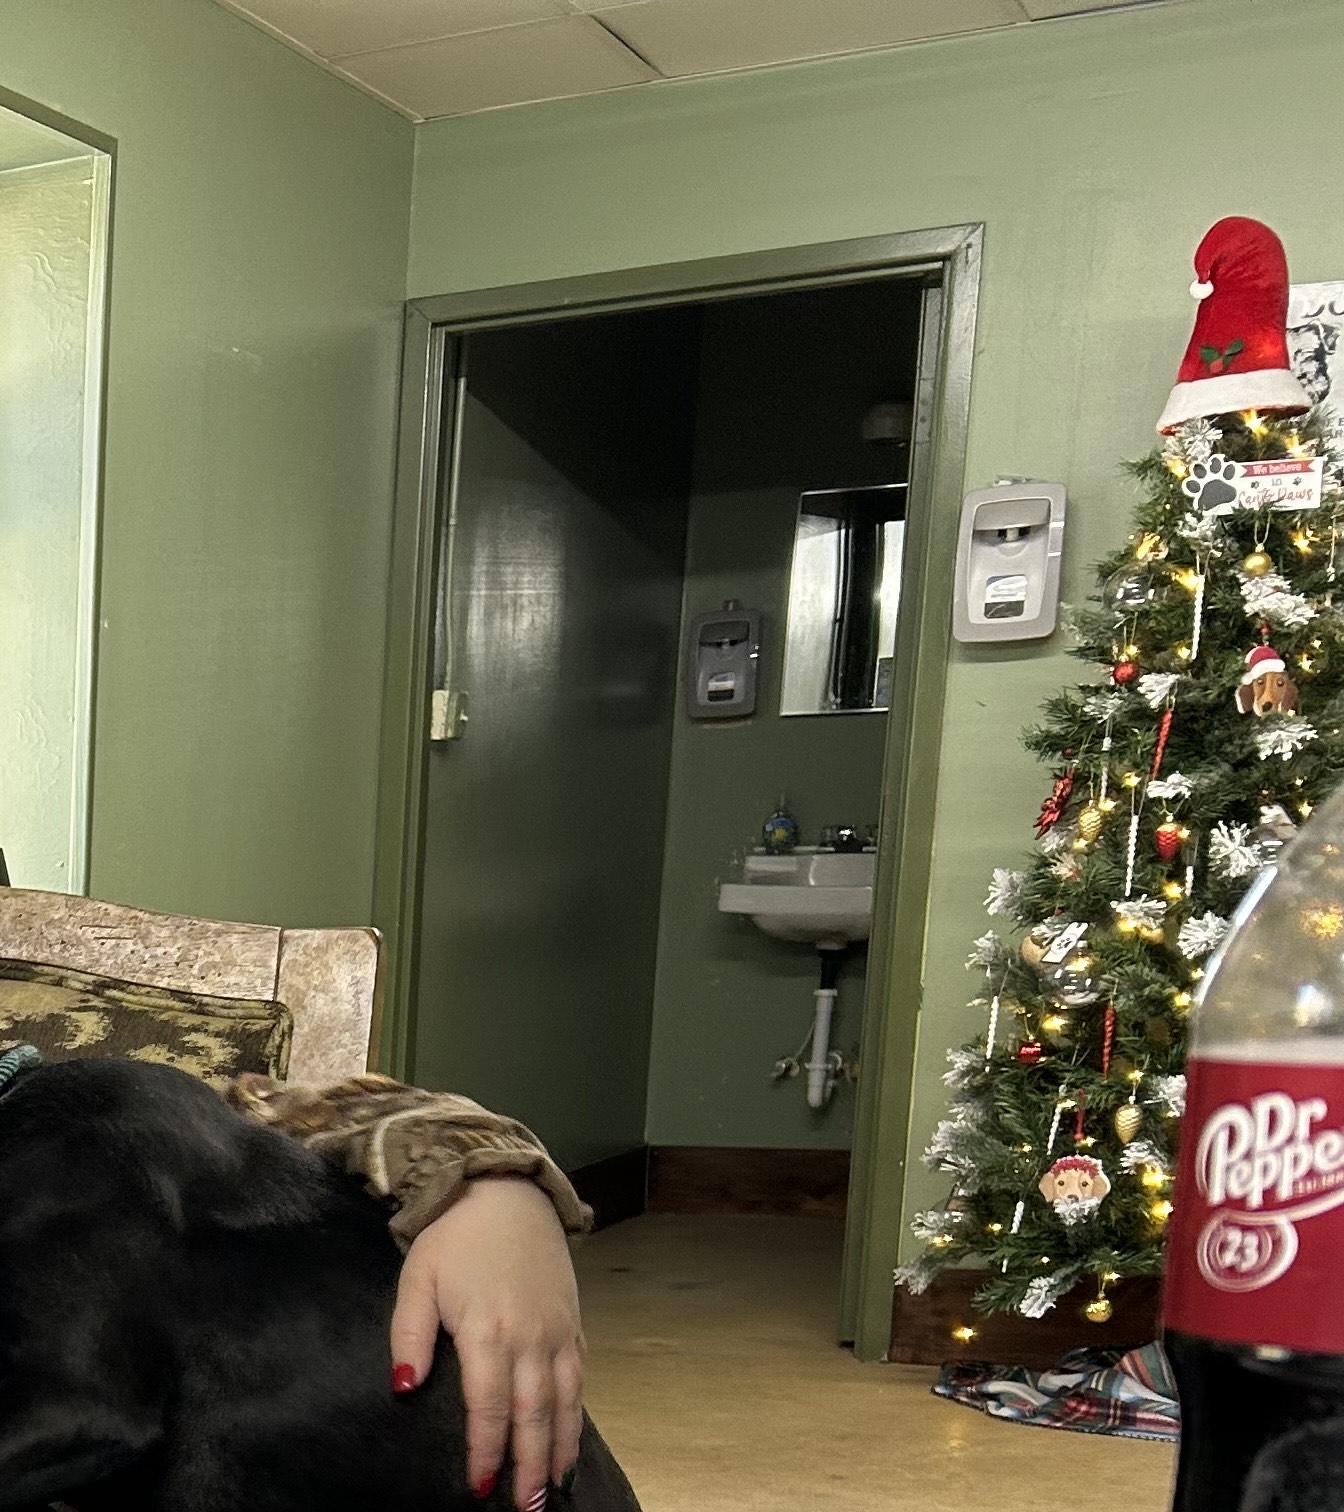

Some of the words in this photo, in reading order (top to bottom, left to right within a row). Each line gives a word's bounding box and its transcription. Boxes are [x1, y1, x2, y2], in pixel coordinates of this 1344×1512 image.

[1252, 1091, 1327, 1155] Dr
[1196, 1103, 1344, 1210] Peppe
[1221, 1228, 1260, 1270] 23
